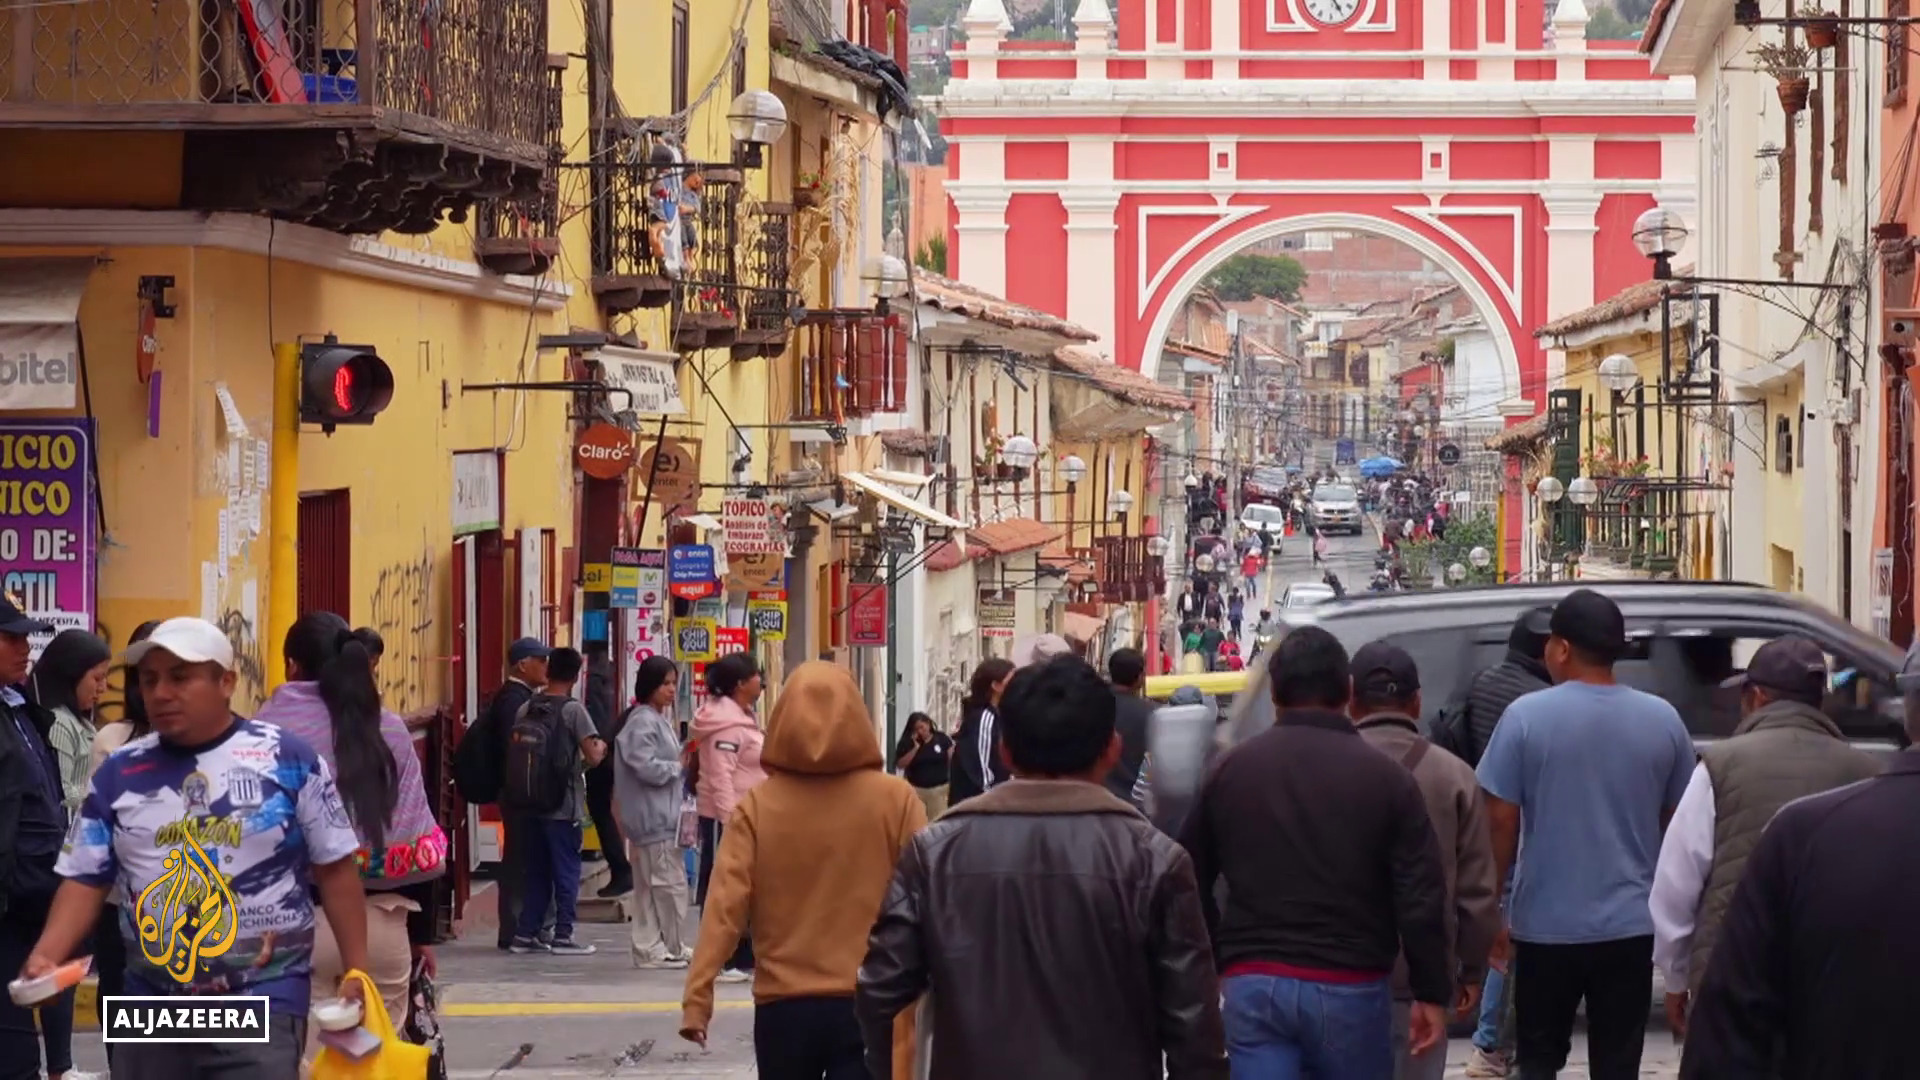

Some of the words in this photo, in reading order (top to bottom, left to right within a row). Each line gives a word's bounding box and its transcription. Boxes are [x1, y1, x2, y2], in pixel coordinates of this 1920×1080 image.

[0, 352, 76, 385] bitel
[0, 434, 76, 470] ICIO
[579, 441, 624, 460] Claro
[33, 528, 76, 561] DE:
[682, 628, 707, 639] CHIP
[240, 904, 275, 917] ANCO
